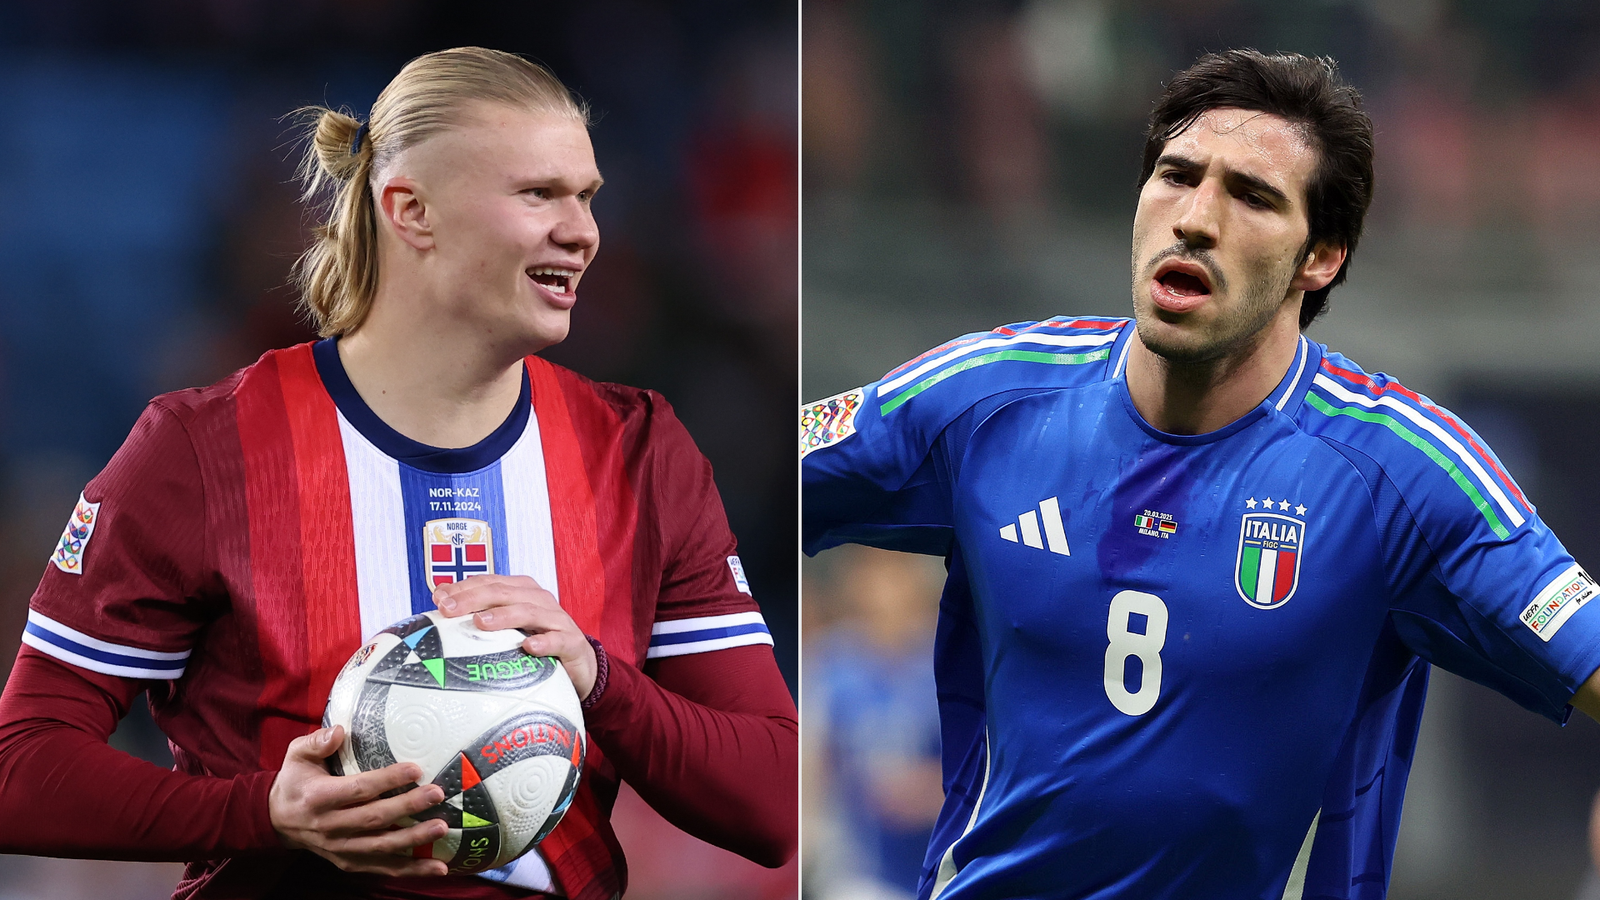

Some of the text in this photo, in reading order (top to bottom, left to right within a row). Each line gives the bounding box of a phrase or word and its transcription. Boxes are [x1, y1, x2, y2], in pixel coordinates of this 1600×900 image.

[429, 488, 479, 497] NOR-KAZ
[429, 501, 482, 511] 17.11.2024
[1143, 509, 1173, 520] 20.03.2025
[446, 522, 468, 531] NORGE
[1246, 520, 1298, 543] ITALIA
[1262, 540, 1279, 549] FIGC
[1523, 603, 1539, 621] UEFA
[1531, 579, 1585, 631] FOUNDATION
[1103, 589, 1169, 716] 8
[480, 723, 572, 764] NATIONS
